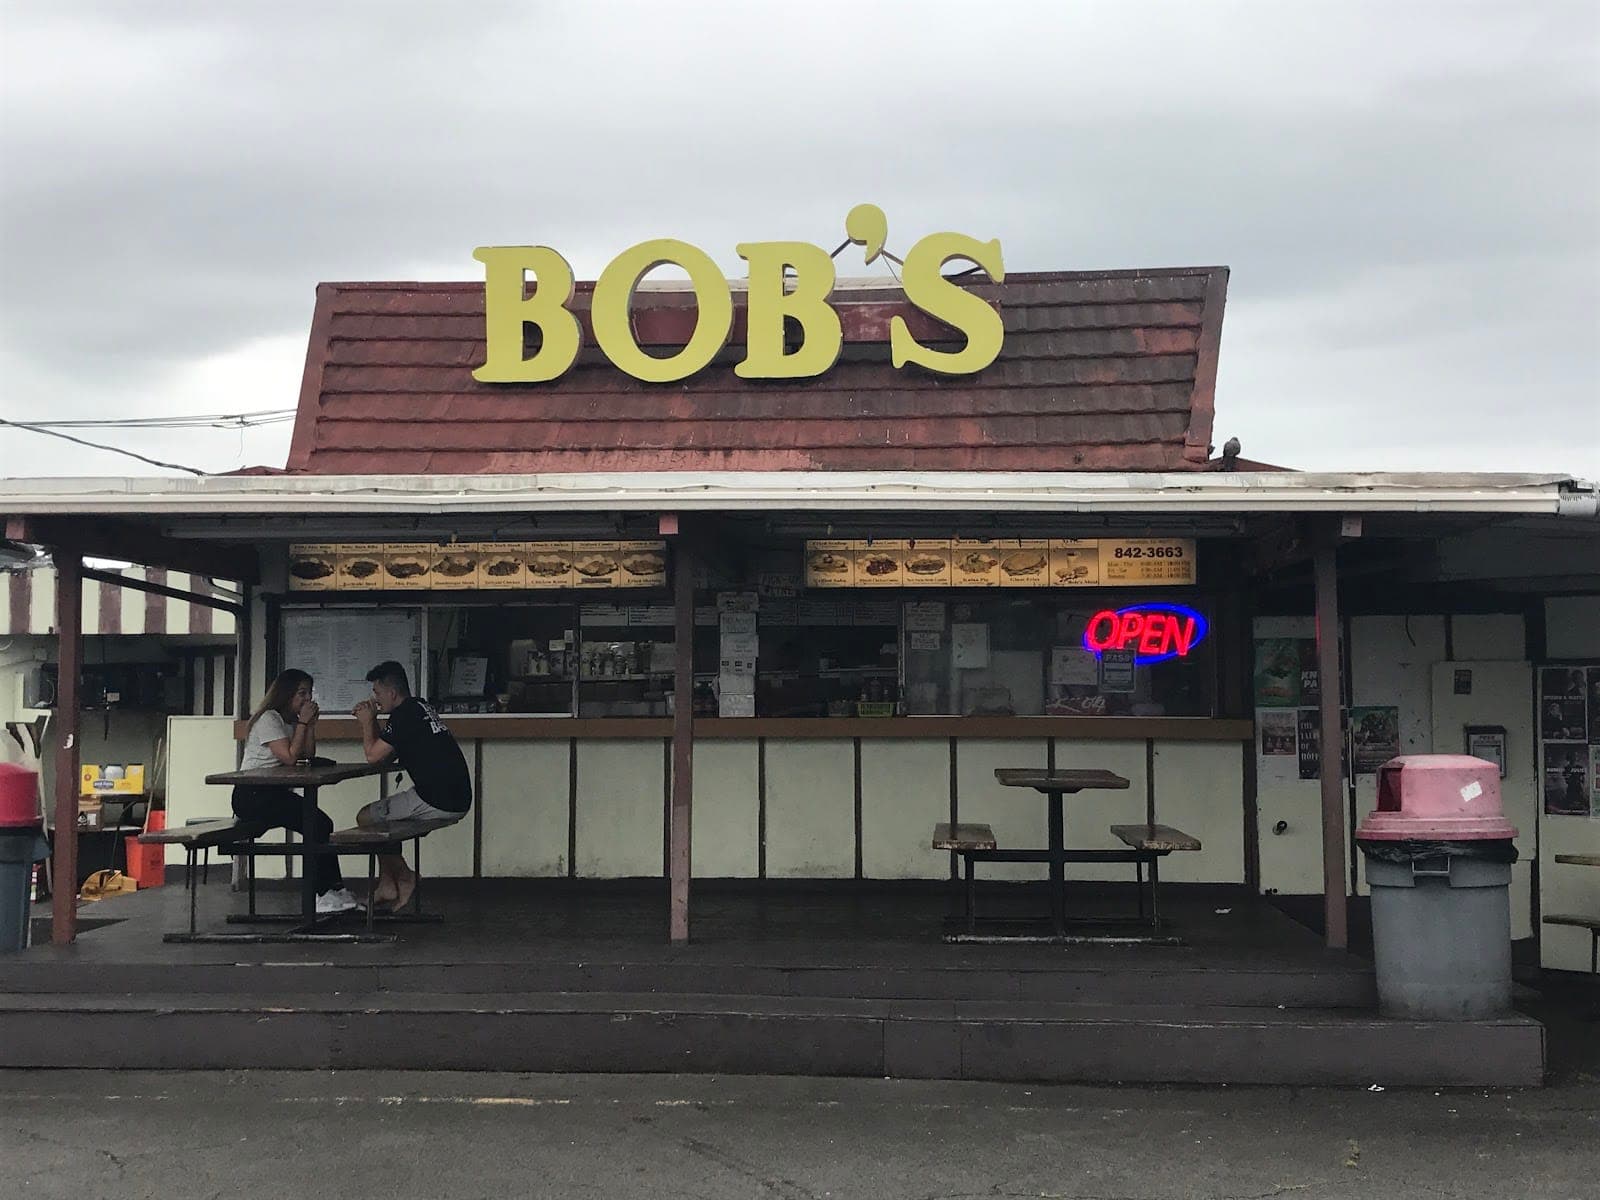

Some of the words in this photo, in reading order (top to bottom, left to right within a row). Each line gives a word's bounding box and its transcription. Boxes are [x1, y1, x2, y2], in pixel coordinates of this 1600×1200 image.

[472, 203, 1005, 383] BOB'S
[1114, 546, 1183, 559] 842-3663
[1085, 609, 1195, 656] OPEN
